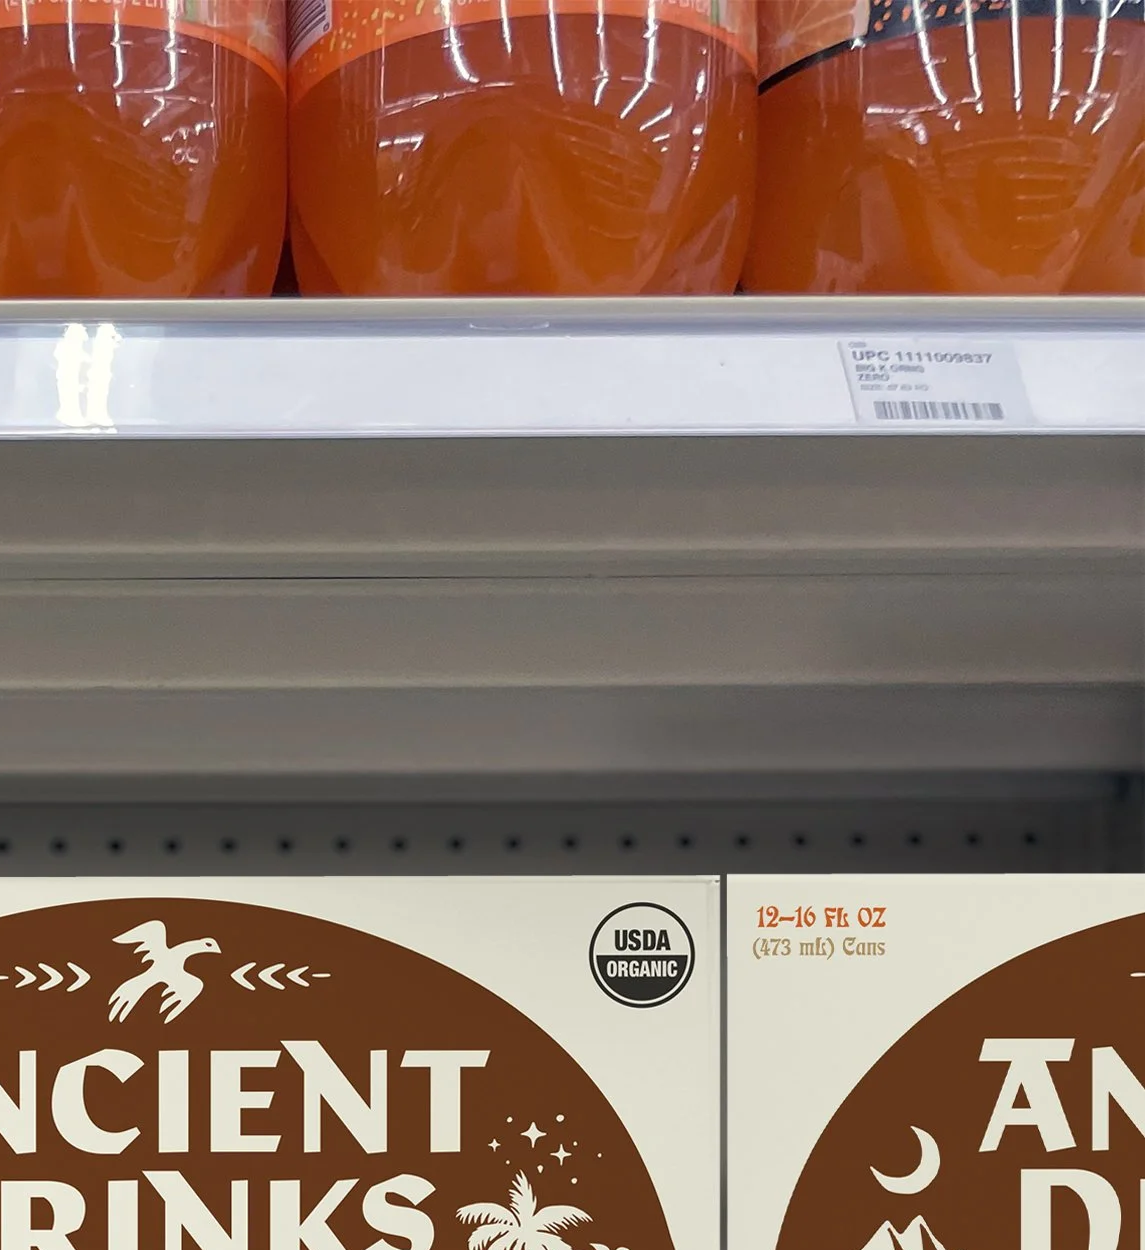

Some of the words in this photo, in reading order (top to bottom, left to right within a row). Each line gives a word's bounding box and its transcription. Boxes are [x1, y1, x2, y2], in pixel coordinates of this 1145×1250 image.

[852, 351, 889, 361] UPC
[757, 906, 816, 927] 12–16
[824, 907, 849, 927] FL
[858, 907, 886, 927] OZ
[614, 929, 670, 951] USDA
[753, 937, 791, 960] (473
[800, 937, 834, 960] mL)
[843, 937, 885, 956] Cans
[606, 960, 678, 978] ORGANIC
